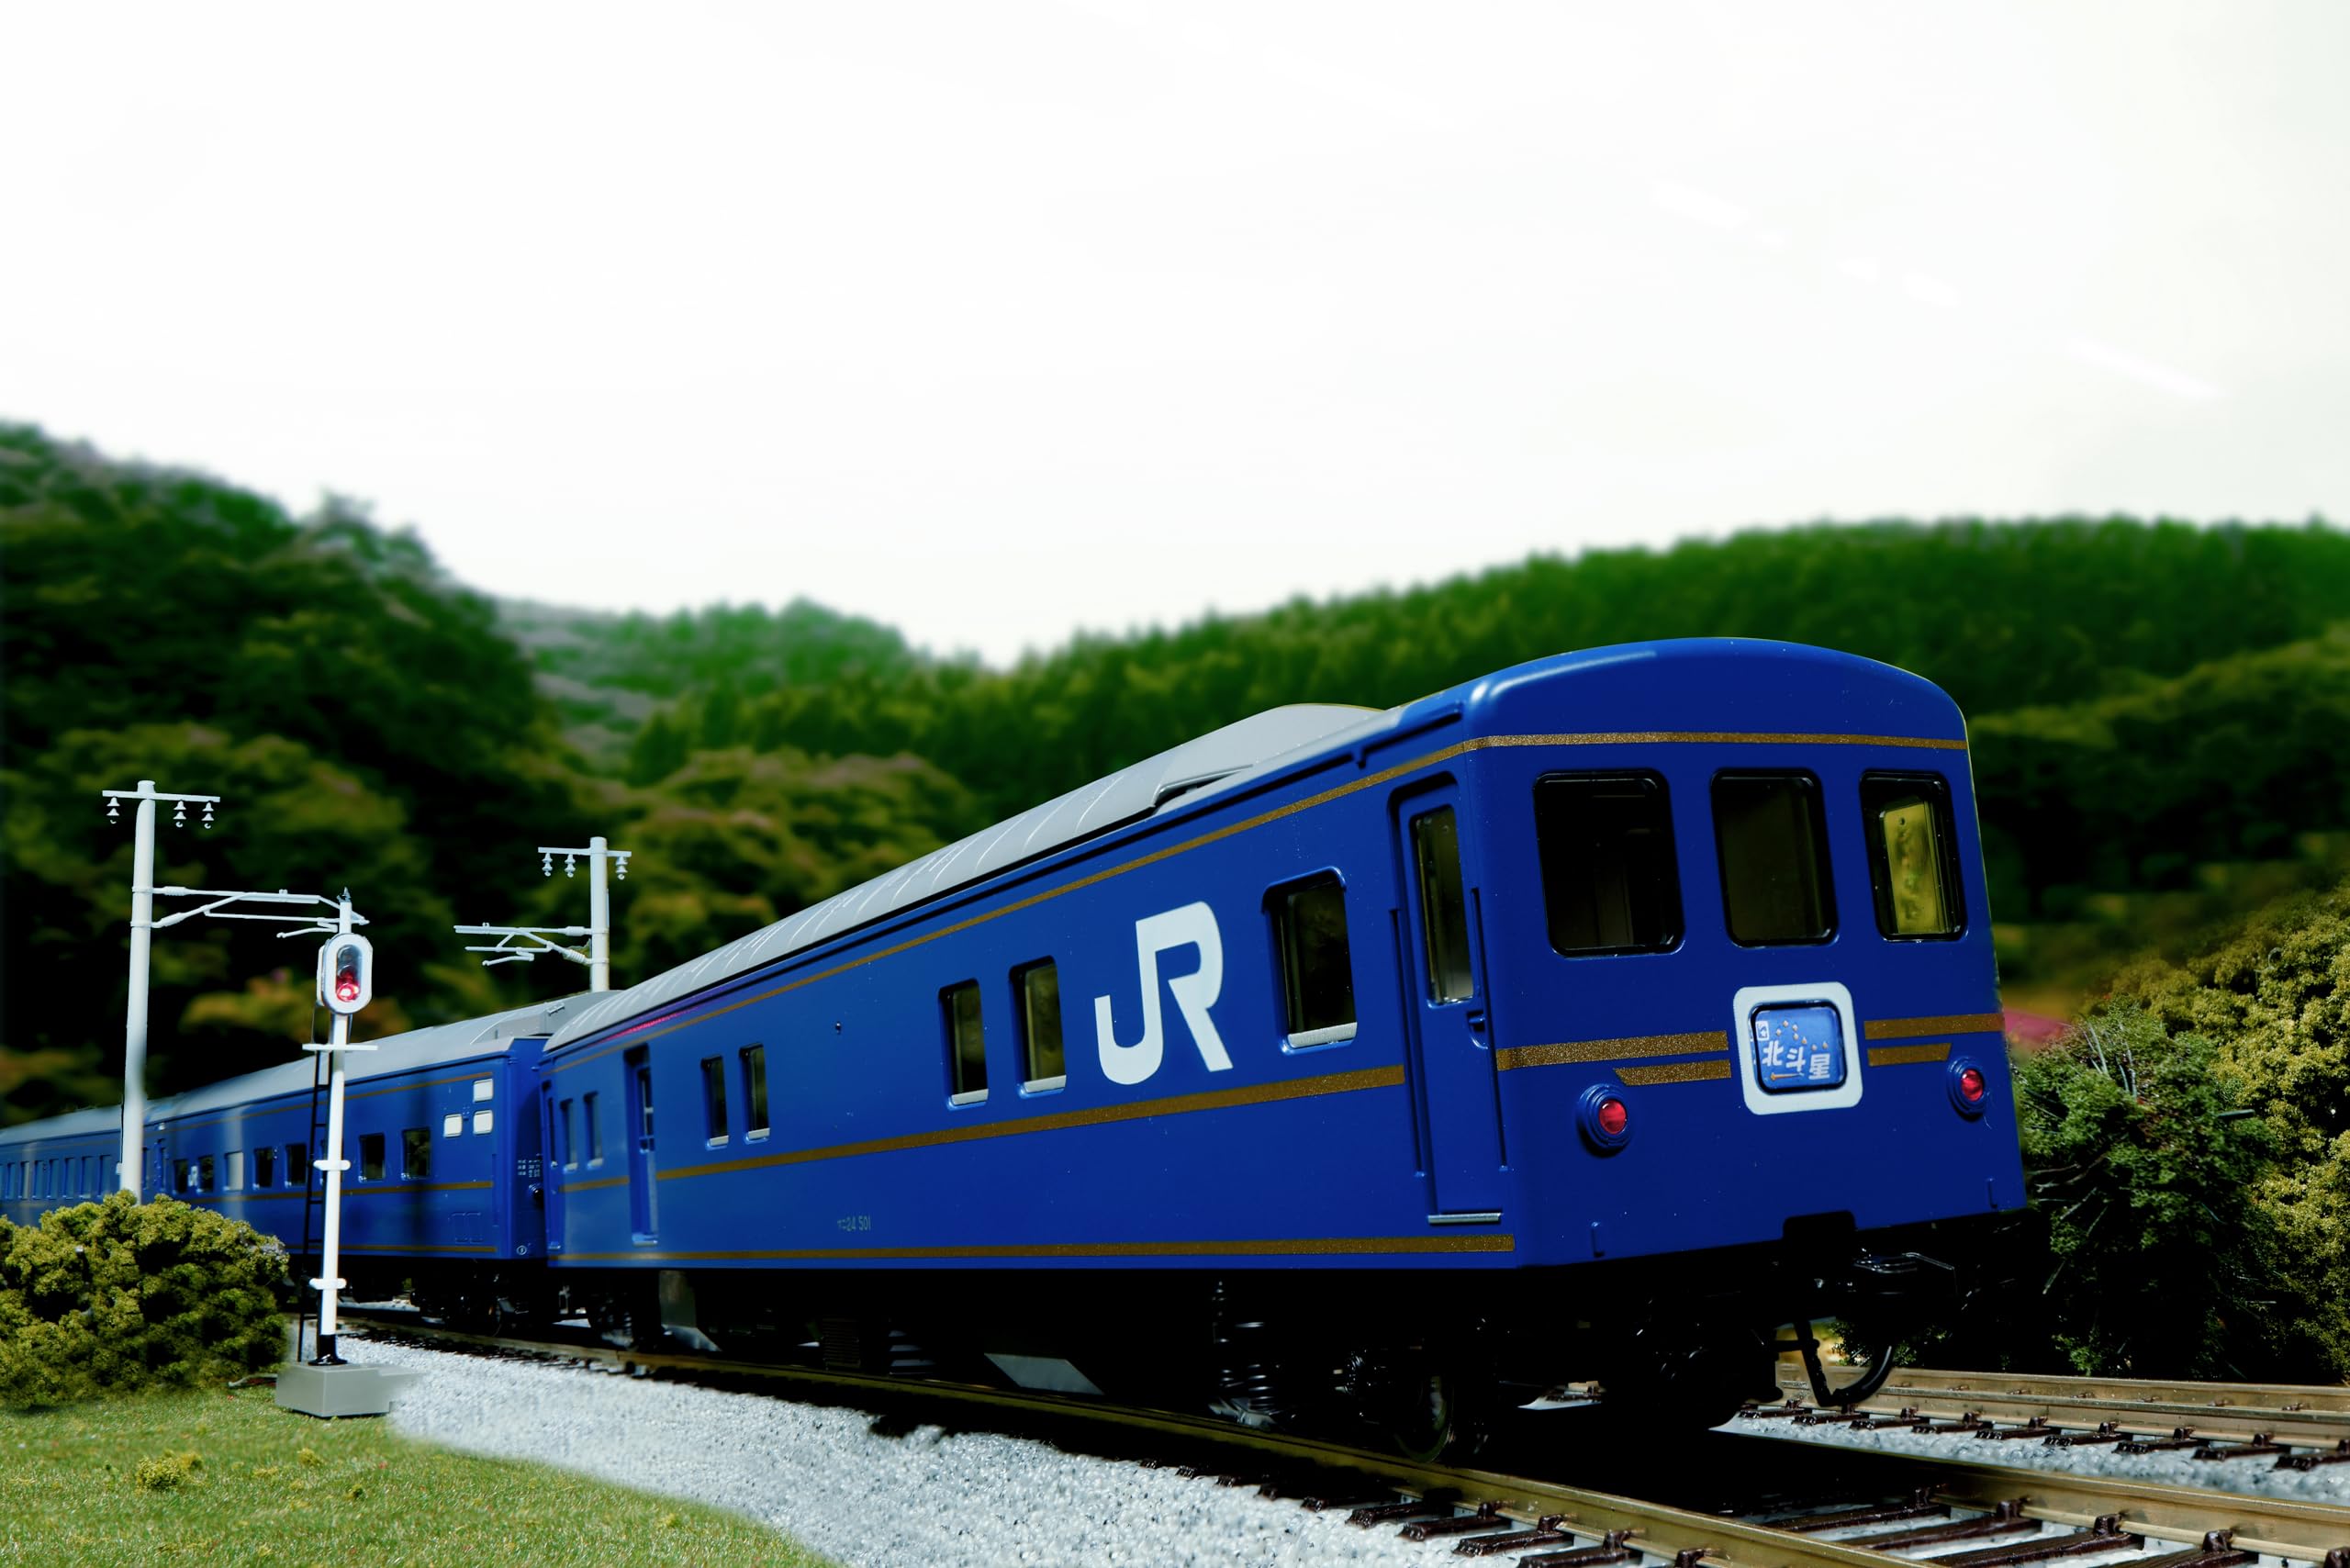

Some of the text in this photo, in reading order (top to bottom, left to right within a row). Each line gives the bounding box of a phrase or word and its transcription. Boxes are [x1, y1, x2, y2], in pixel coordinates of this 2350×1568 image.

[1094, 901, 1234, 1085] JR
[1762, 1040, 1830, 1080] 北斗星
